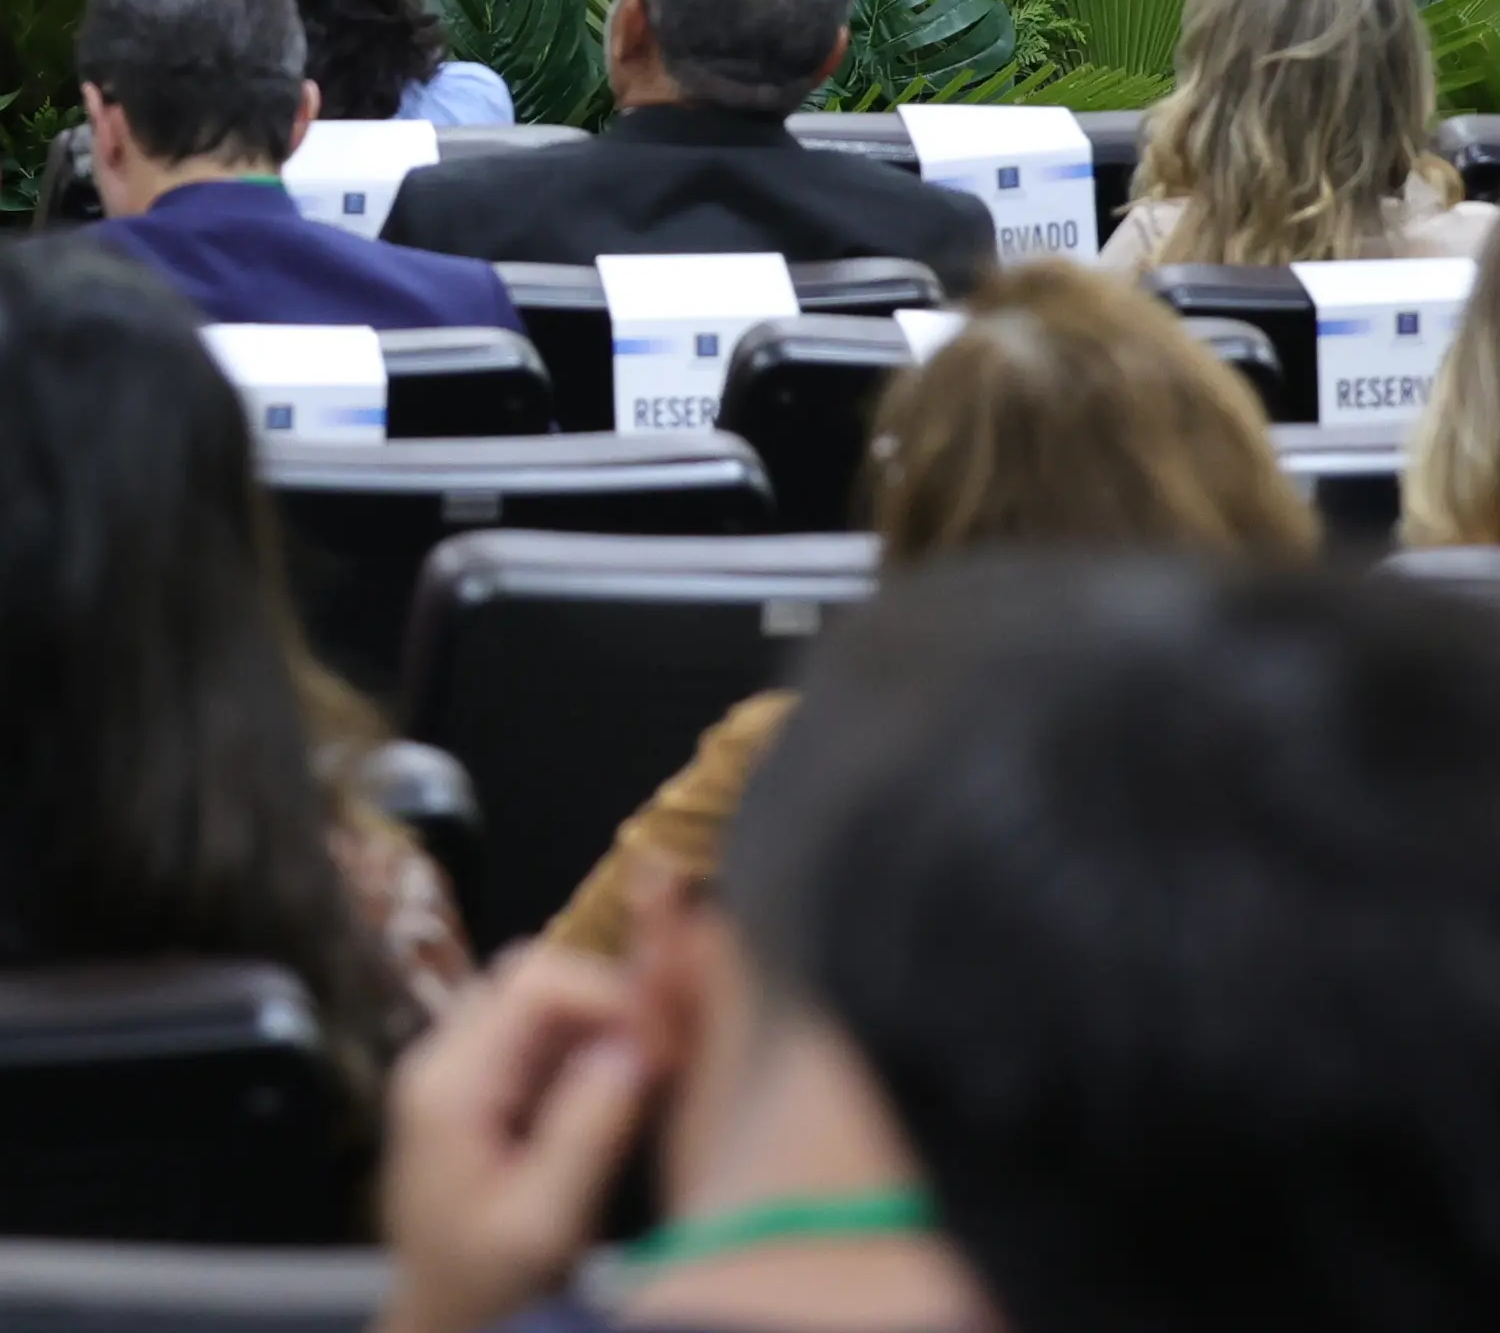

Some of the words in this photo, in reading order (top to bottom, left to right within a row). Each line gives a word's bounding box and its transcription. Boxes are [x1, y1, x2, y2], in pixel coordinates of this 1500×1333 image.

[999, 219, 1078, 257] RVADO
[1336, 375, 1434, 410] RESERV
[633, 396, 720, 429] RESER
